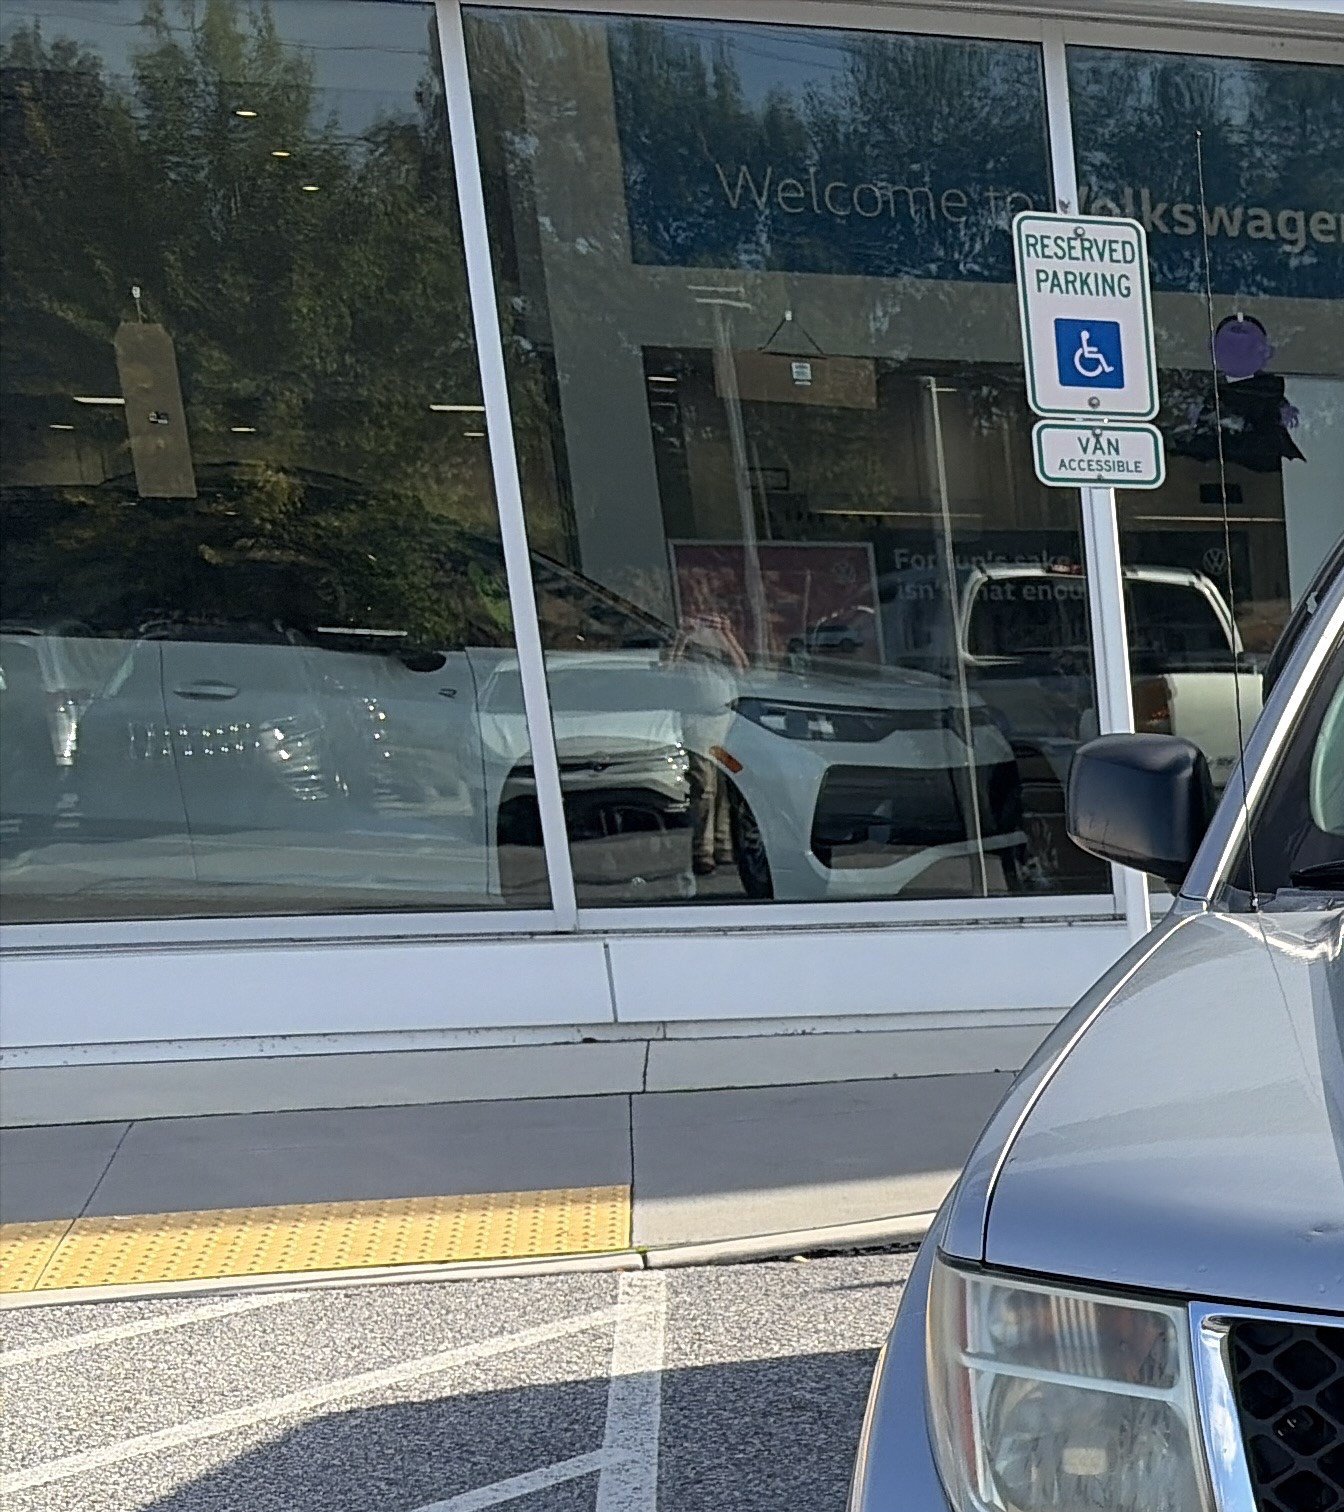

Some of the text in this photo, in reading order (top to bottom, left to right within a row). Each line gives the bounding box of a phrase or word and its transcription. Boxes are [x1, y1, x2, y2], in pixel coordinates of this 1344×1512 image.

[715, 163, 968, 222] Welcome
[1025, 233, 1136, 265] RESERVED
[1036, 269, 1131, 298] PARKING
[1077, 437, 1120, 456] VAN
[1058, 458, 1143, 473] ACCESSIBLE
[894, 548, 937, 571] For
